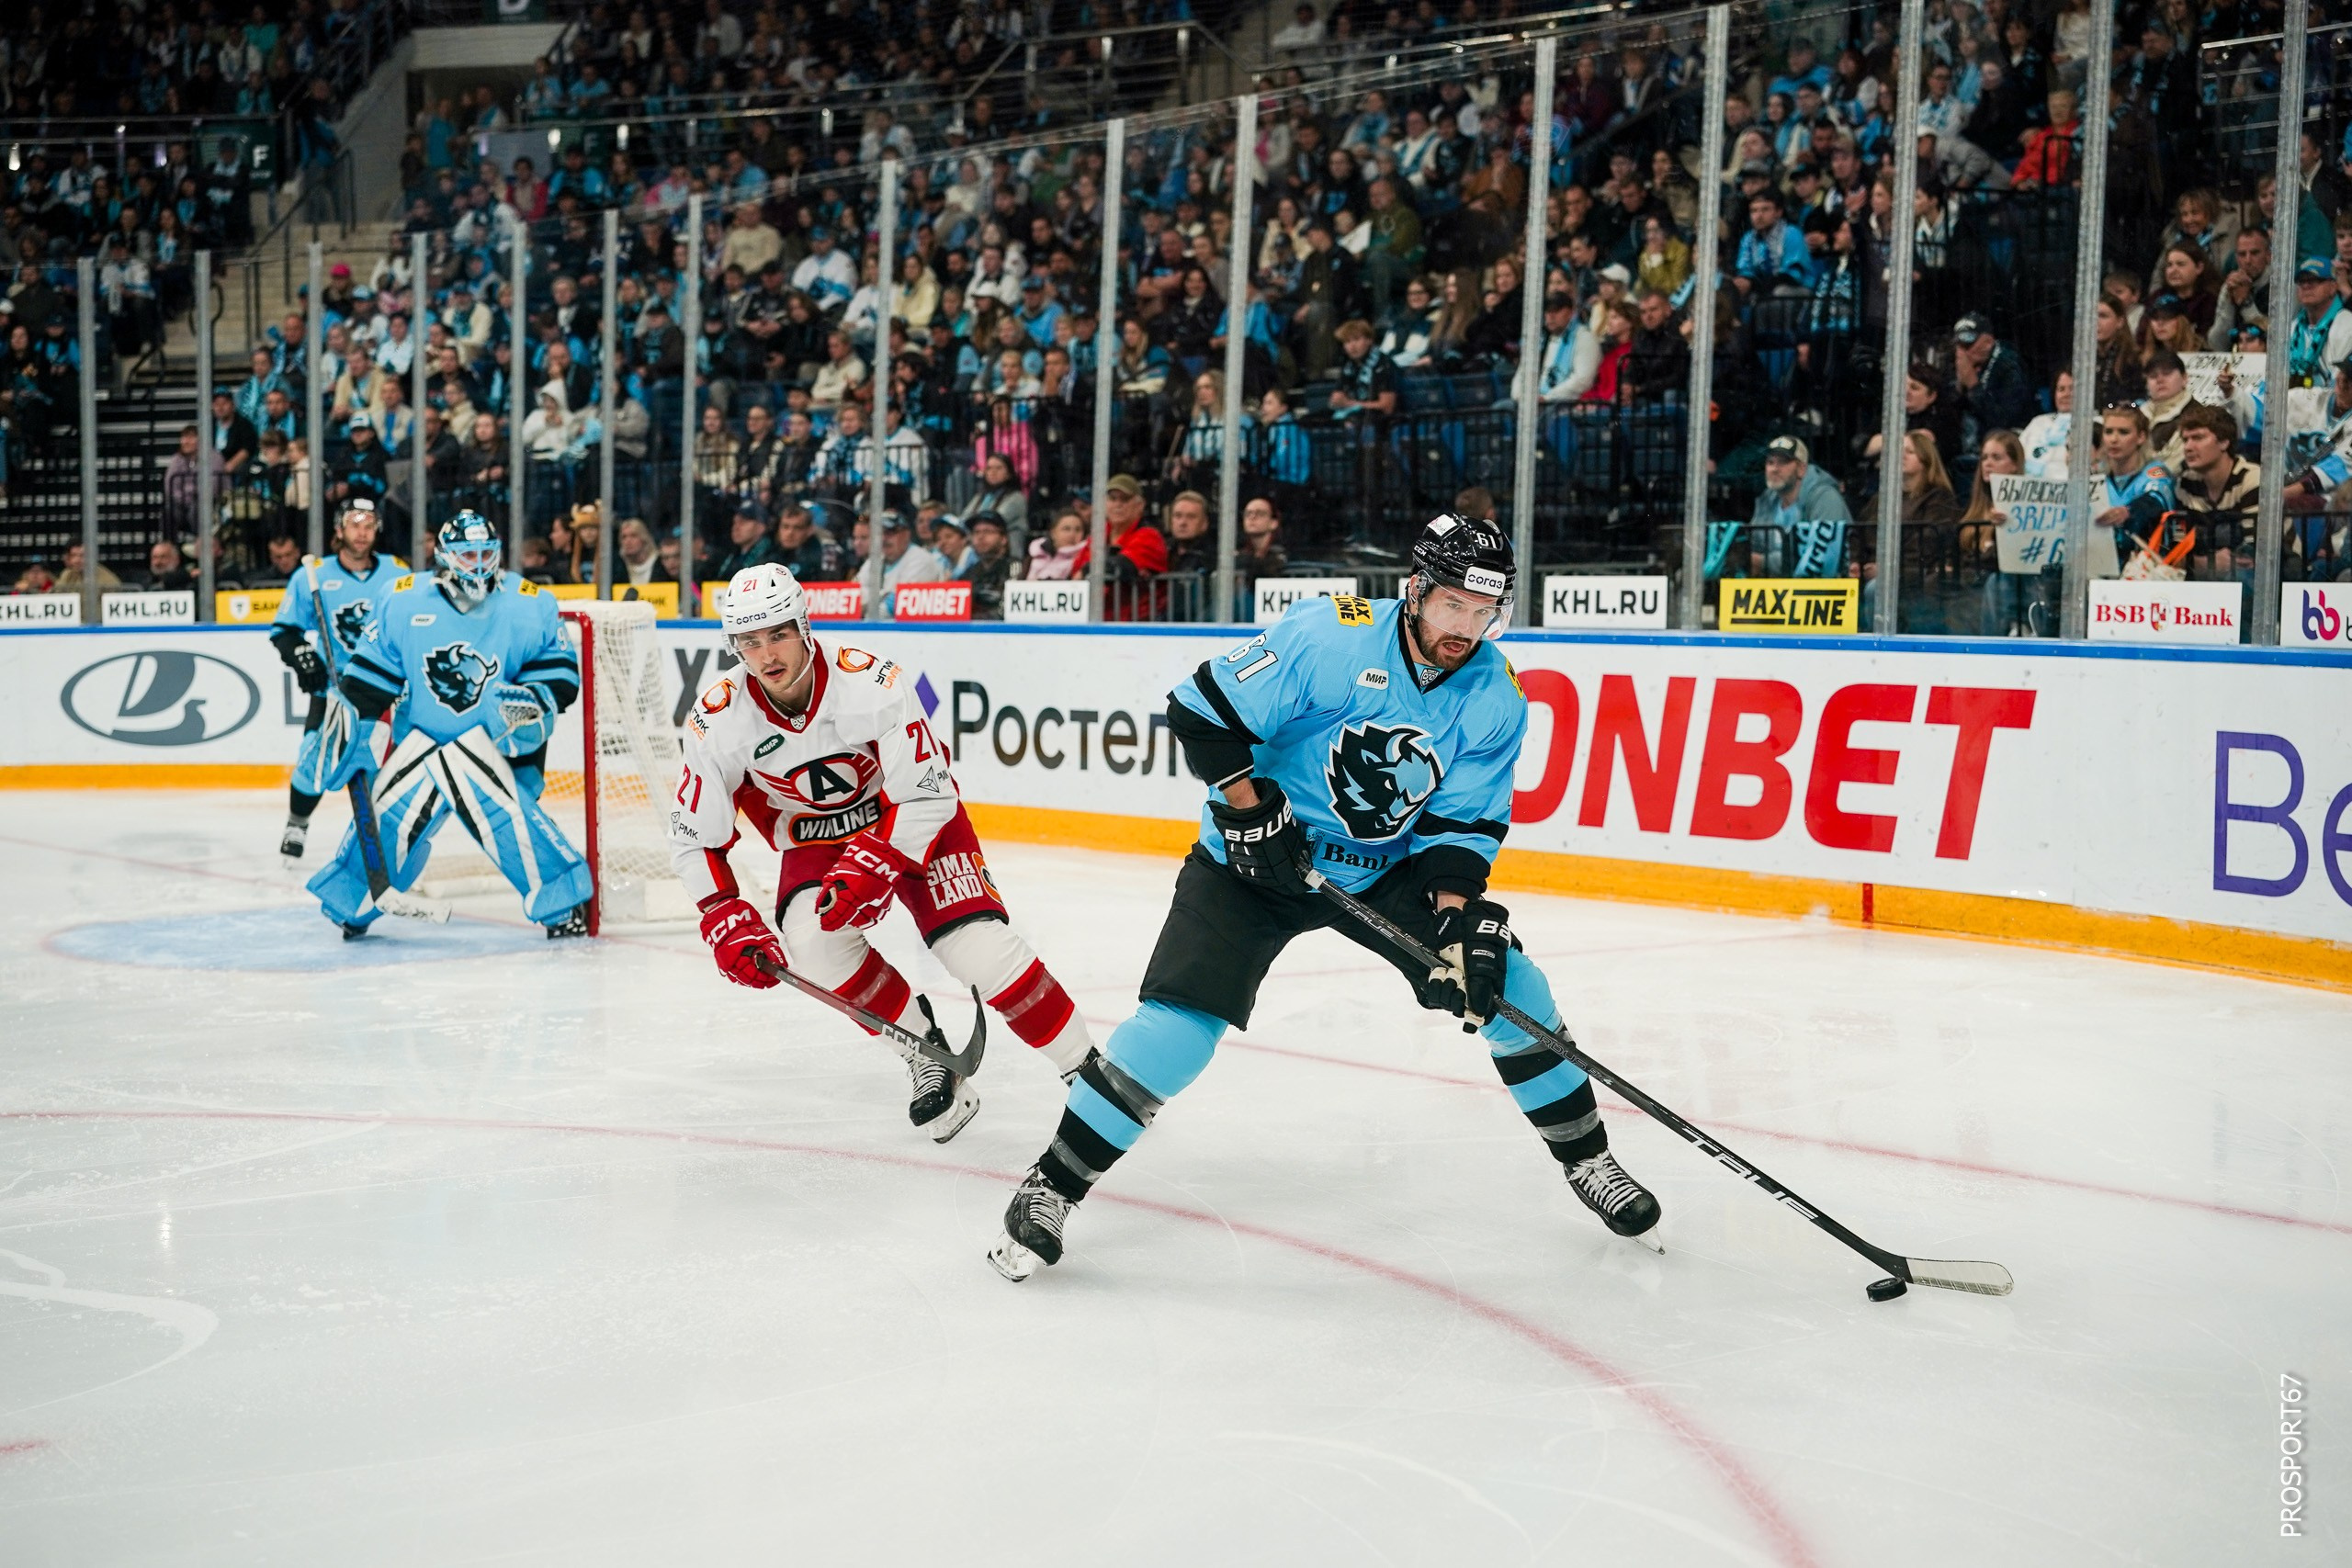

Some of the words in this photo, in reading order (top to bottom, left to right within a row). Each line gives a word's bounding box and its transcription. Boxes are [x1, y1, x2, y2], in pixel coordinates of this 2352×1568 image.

[1413, 545, 1427, 557] CCM
[1476, 533, 1498, 549] 61
[742, 579, 758, 592] 21
[1467, 573, 1503, 590] согаз
[109, 601, 188, 618] KHL.RU
[896, 589, 970, 616] FONBET
[1012, 592, 1083, 613] KHL.RU
[1334, 597, 1356, 621] LINE
[1553, 590, 1658, 615] KHL.RU
[1732, 589, 1789, 615] MAX
[1788, 599, 1847, 626] LINE
[2096, 604, 2145, 624] BSB
[2175, 606, 2233, 626] Bank
[736, 612, 767, 626] согаз
[1227, 634, 1279, 683] 61
[1365, 672, 1387, 685] МИР
[905, 717, 939, 764] 21
[953, 681, 1200, 783] Ростел
[758, 739, 780, 755] МИР
[677, 763, 702, 815] 21
[843, 844, 899, 884] CCM
[926, 852, 976, 887] SIMA
[930, 874, 984, 910] LAND
[1342, 900, 1396, 939] TRUE
[881, 1023, 922, 1055] CCM
[1682, 1128, 1819, 1221] TRUE
